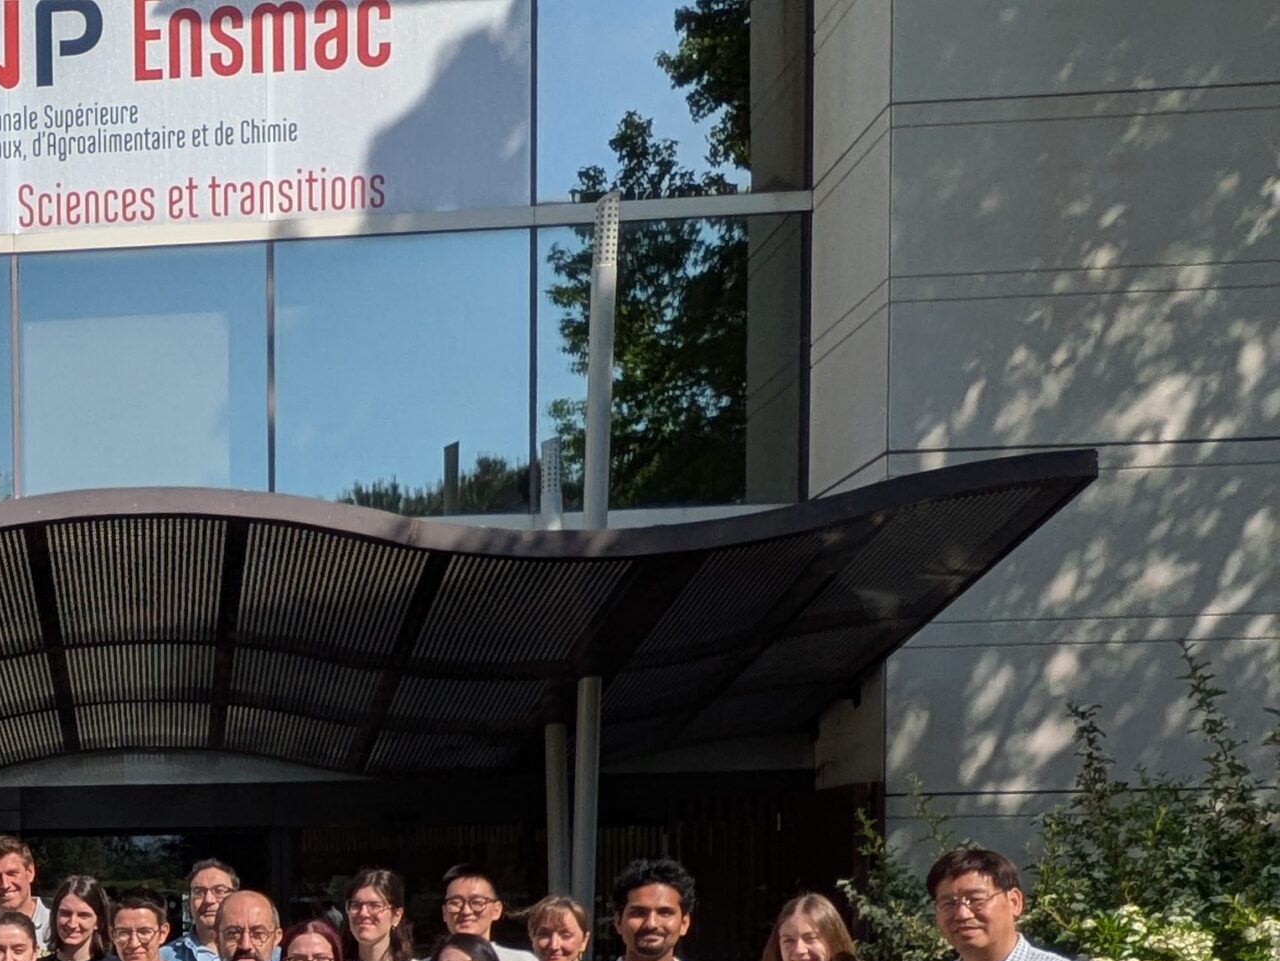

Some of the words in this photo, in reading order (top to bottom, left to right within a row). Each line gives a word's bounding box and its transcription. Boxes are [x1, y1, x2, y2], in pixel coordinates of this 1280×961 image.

[133, 0, 392, 82] Ensmac
[32, 127, 186, 162] d'Agroalimentaire
[191, 124, 209, 148] et
[214, 120, 234, 146] de
[240, 117, 298, 145] Chimie
[43, 102, 138, 134] Supérieure
[18, 182, 156, 228] Sciences
[168, 176, 199, 220] et
[208, 166, 386, 217] transitions
